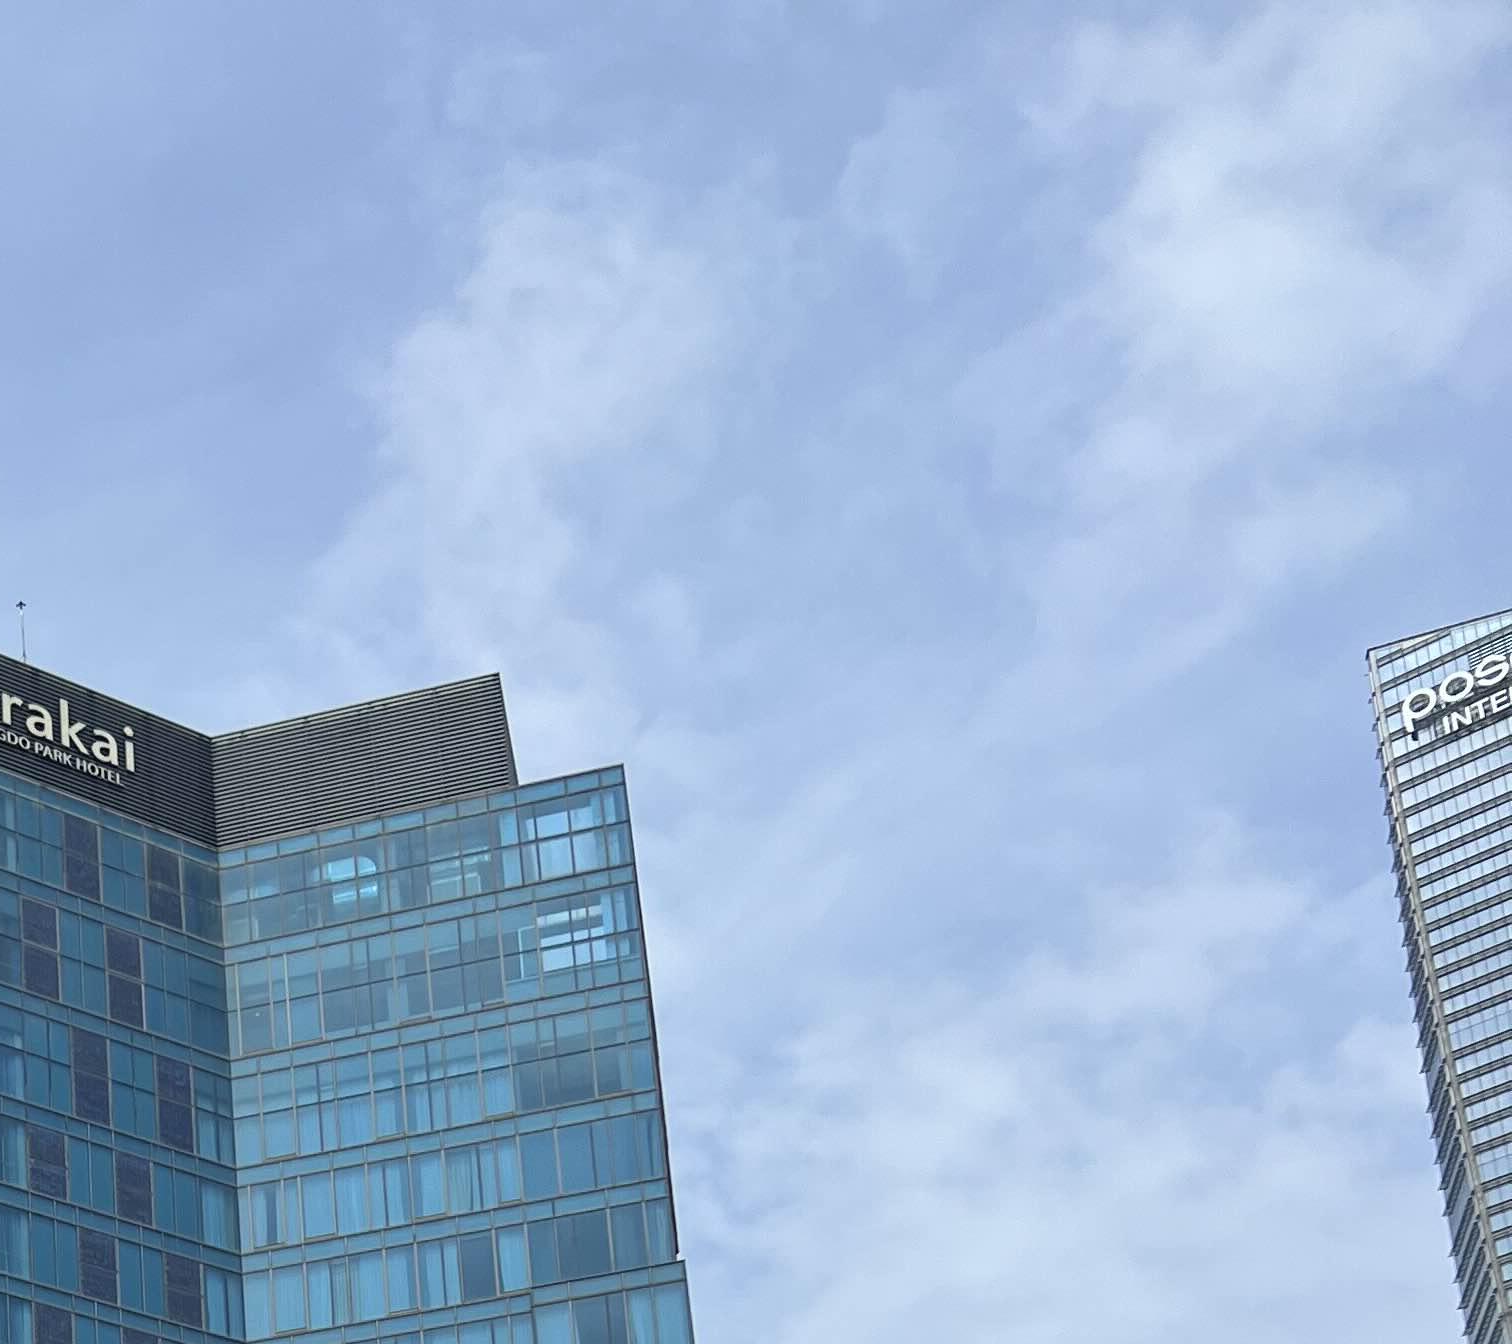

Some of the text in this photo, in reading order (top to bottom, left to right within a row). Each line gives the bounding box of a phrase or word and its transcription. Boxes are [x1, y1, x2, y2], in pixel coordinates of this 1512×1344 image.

[1402, 654, 1512, 733] pos
[1441, 686, 1512, 734] INTE
[34, 741, 74, 768] PARK
[75, 757, 126, 788] HOTEL
